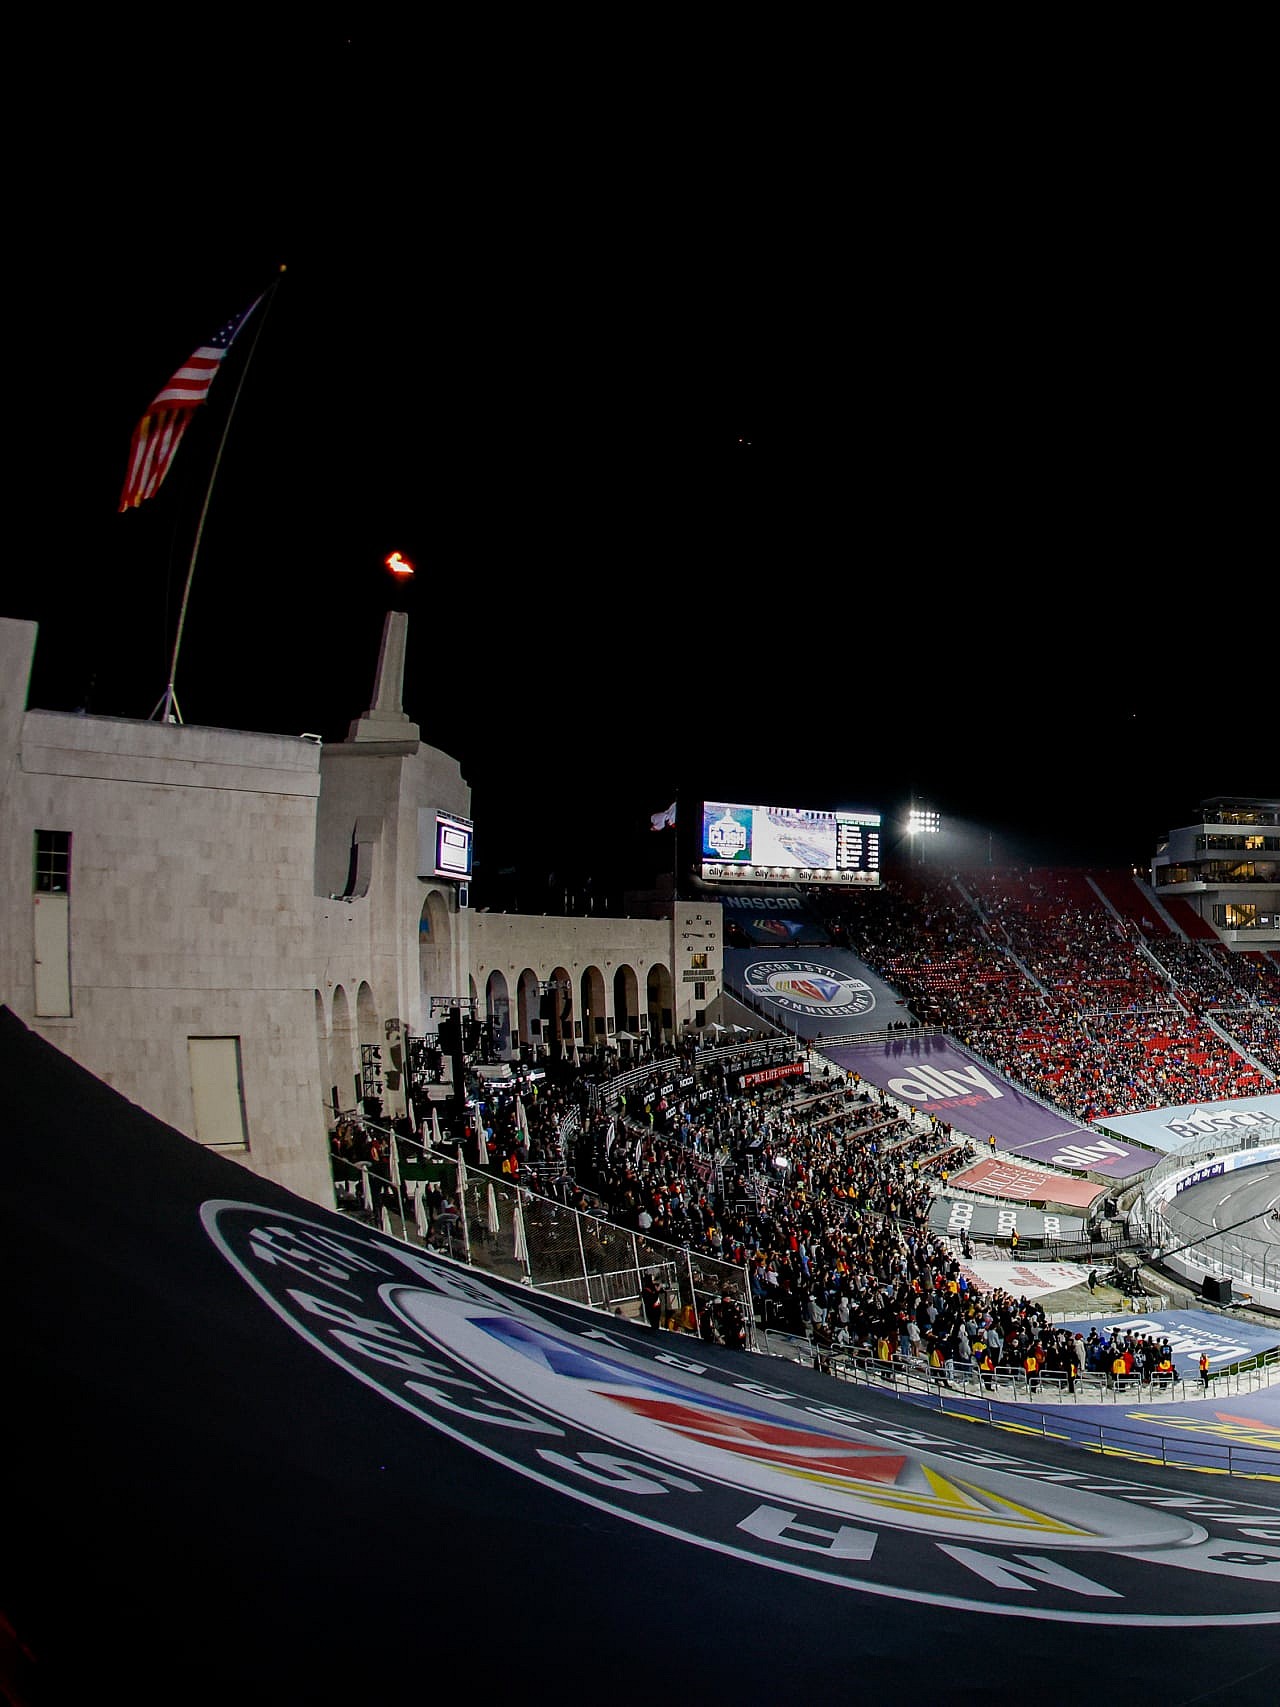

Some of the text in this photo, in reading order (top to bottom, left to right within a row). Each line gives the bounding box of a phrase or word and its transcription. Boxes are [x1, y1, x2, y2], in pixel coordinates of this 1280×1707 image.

[709, 867, 724, 878] ally
[755, 869, 769, 880] ally
[799, 870, 812, 881] ally
[841, 871, 854, 882] ally
[729, 896, 801, 909] NASCAR
[751, 963, 836, 980] NASCAR 75TH
[778, 992, 869, 1016] ANNIVERSARY
[660, 1083, 674, 1097] NOCO
[680, 1076, 694, 1088] NOCO
[887, 1064, 1004, 1101] ally
[1165, 1111, 1280, 1138] BUSCH
[1051, 1140, 1130, 1167] ally
[967, 1168, 1020, 1194] TRUE
[946, 1202, 974, 1233] NOCO
[248, 1225, 395, 1302] 75TH
[1177, 1323, 1242, 1345] TEQUILA
[286, 1287, 1126, 1599] NASCAR
